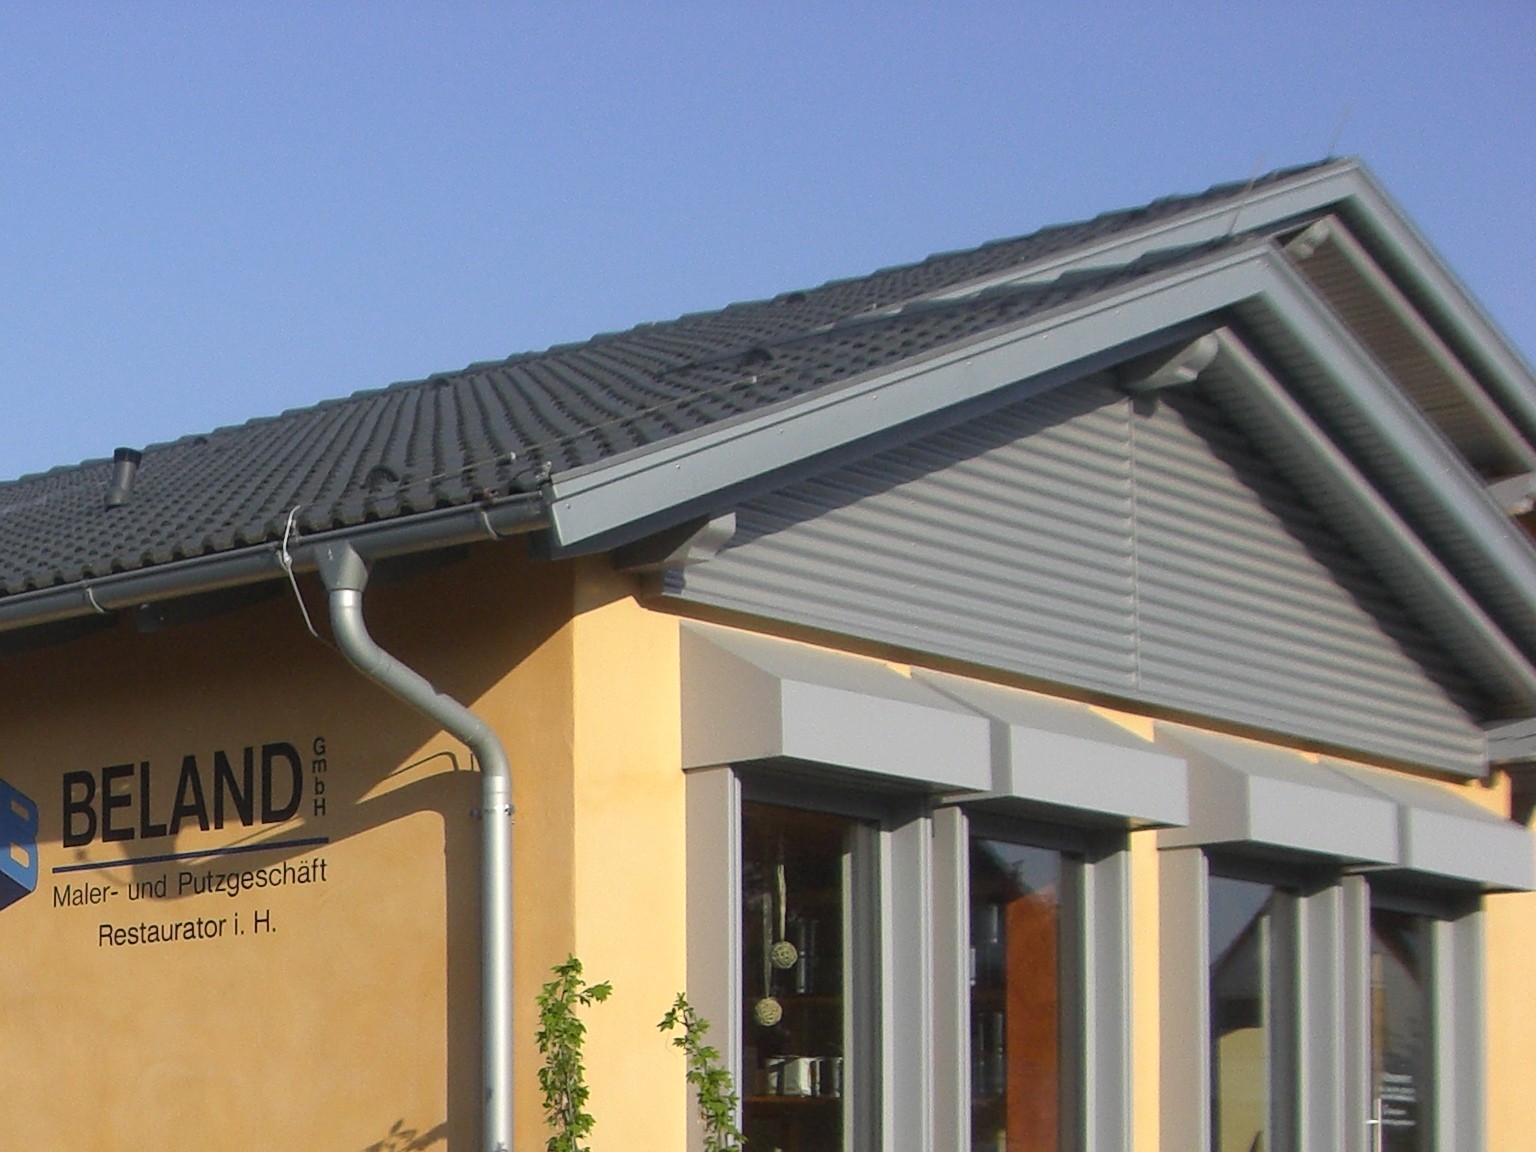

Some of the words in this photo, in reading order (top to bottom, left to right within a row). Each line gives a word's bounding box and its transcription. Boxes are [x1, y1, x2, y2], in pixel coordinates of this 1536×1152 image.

[63, 742, 303, 848] BELAND
[312, 737, 327, 817] GmbH
[53, 883, 119, 908] Maler-
[128, 875, 167, 901] und
[178, 858, 328, 899] Putzgeschäft
[99, 917, 227, 947] Restaurator
